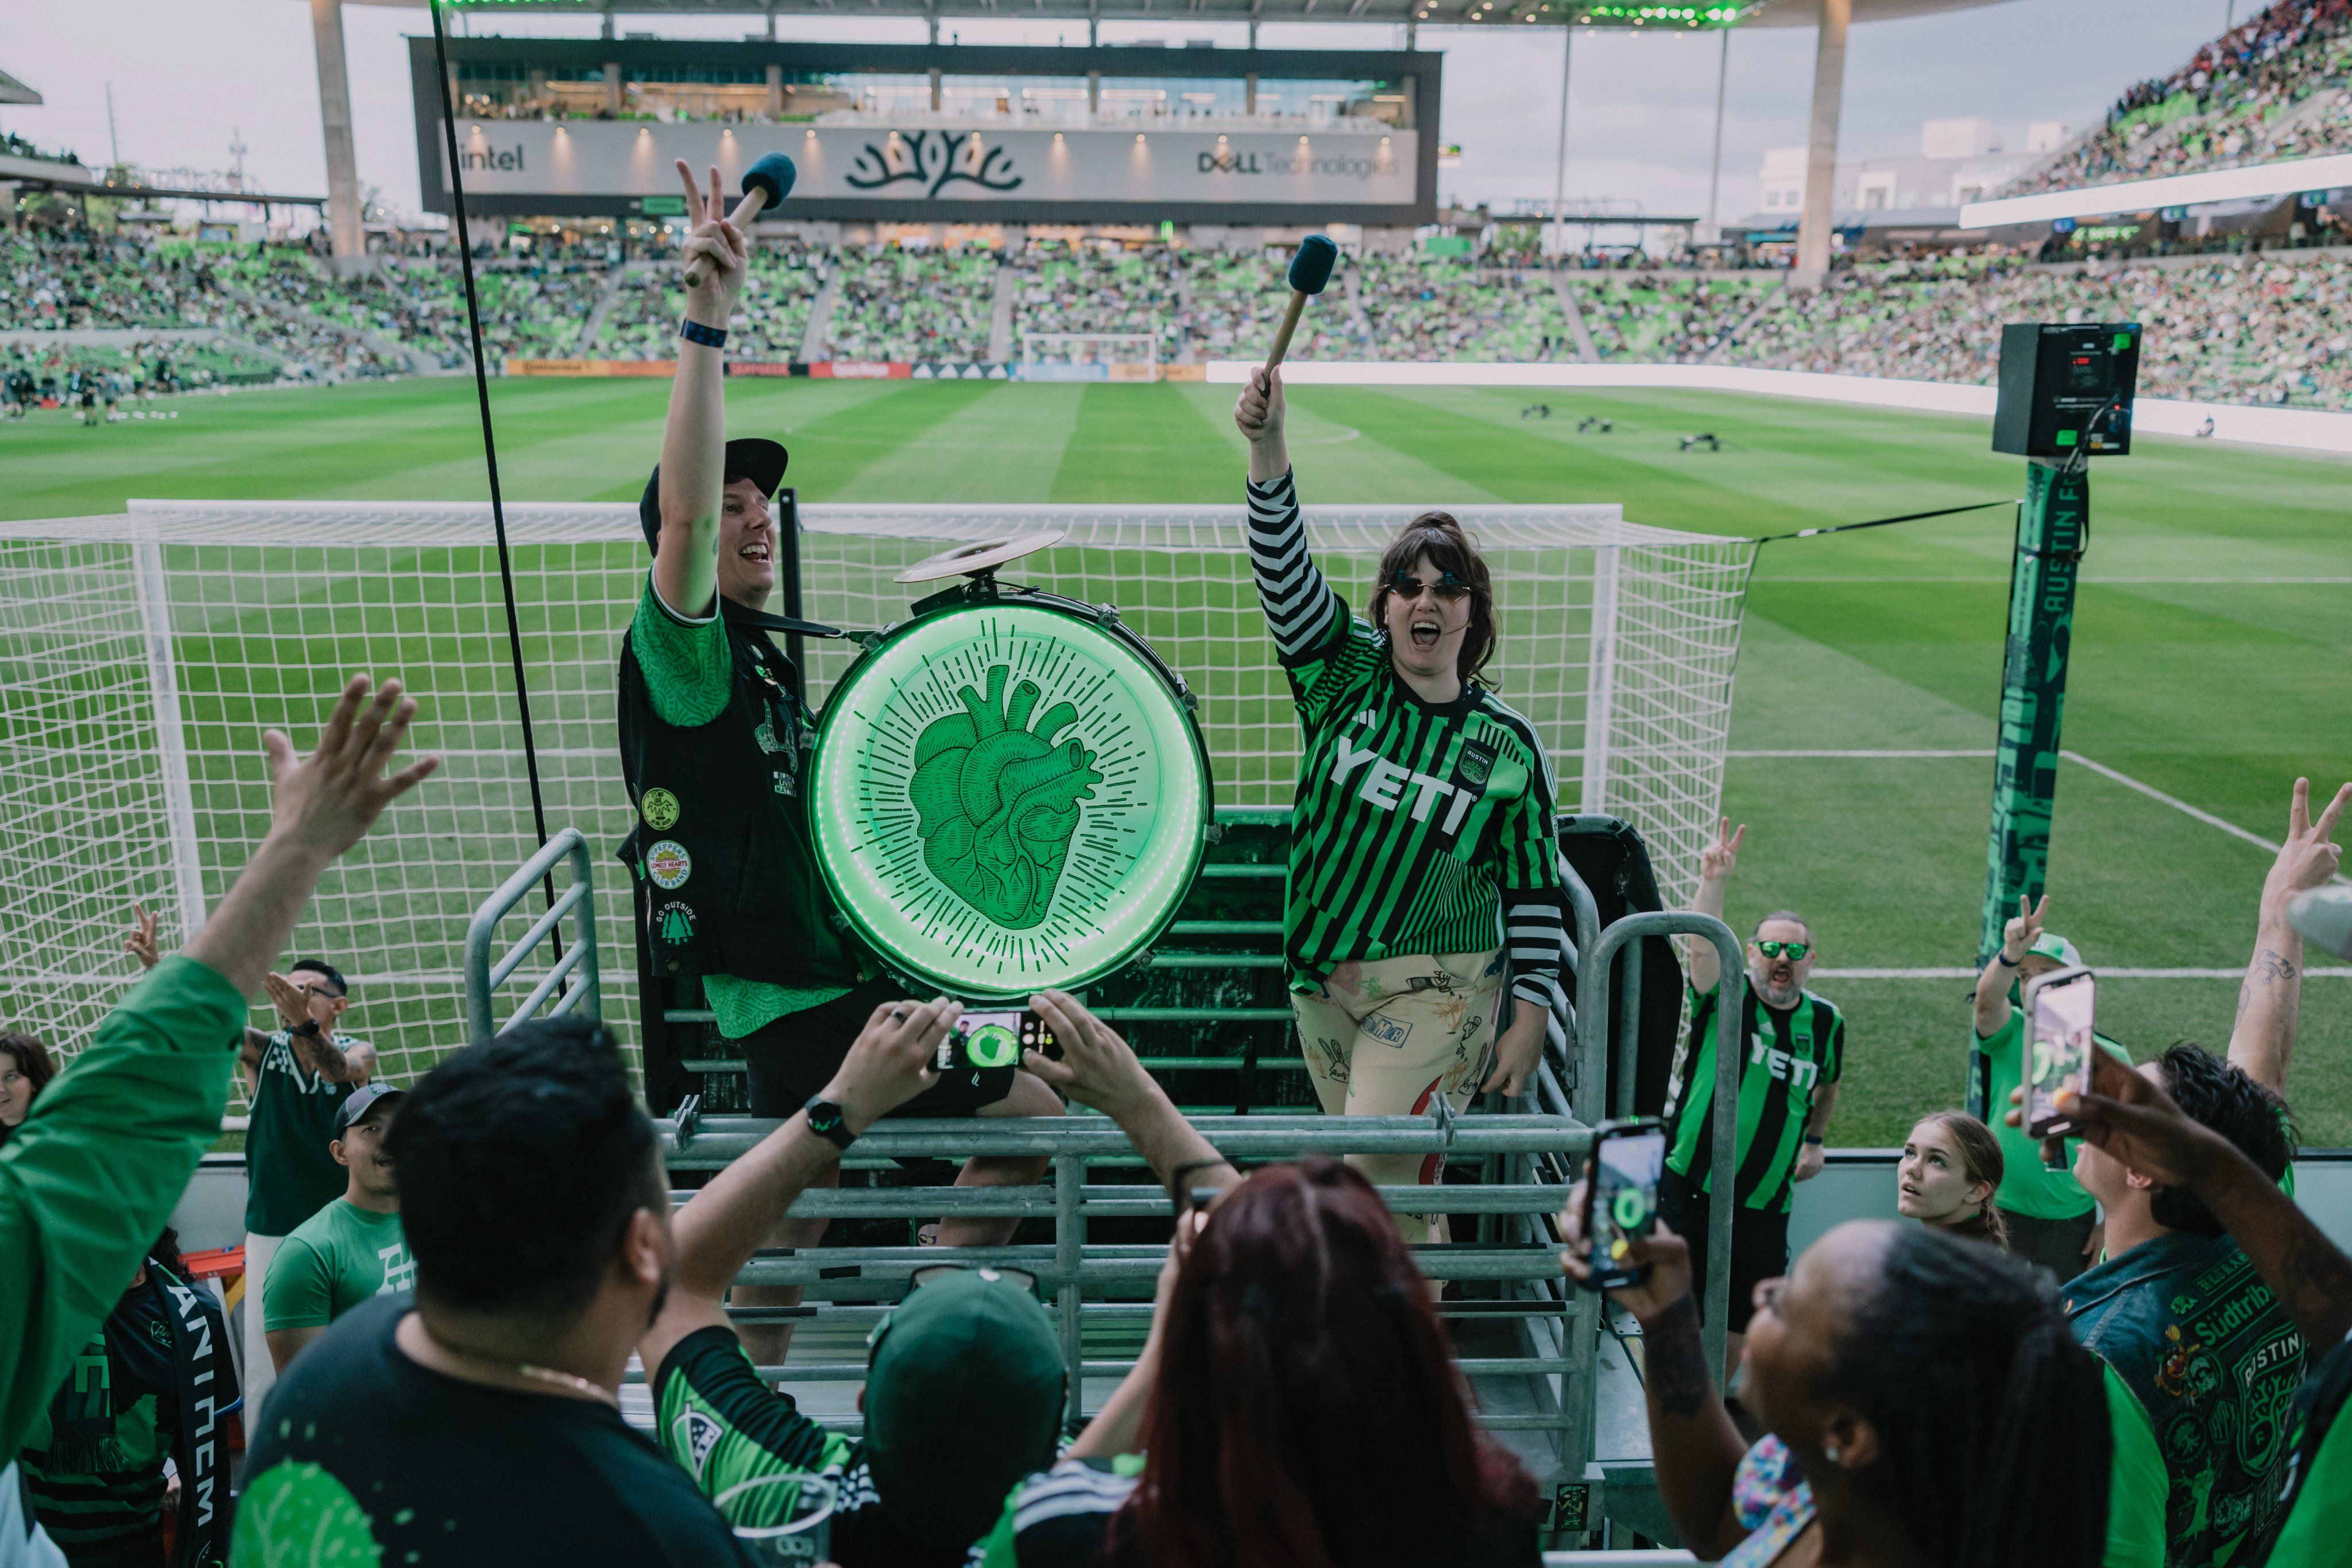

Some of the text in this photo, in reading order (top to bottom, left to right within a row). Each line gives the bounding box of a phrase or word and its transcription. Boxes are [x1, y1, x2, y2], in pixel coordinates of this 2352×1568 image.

[460, 144, 523, 171] intel
[1197, 152, 1262, 173] DELL
[2044, 510, 2078, 612] AUSTIN
[1467, 750, 1488, 765] AUSTIN
[654, 843, 686, 859] PEPPERS
[653, 869, 687, 886] CLUB BAND
[656, 901, 696, 922] GO OUTSIDE
[1751, 1033, 1818, 1090] YETI
[2195, 1283, 2276, 1346] Südtrib
